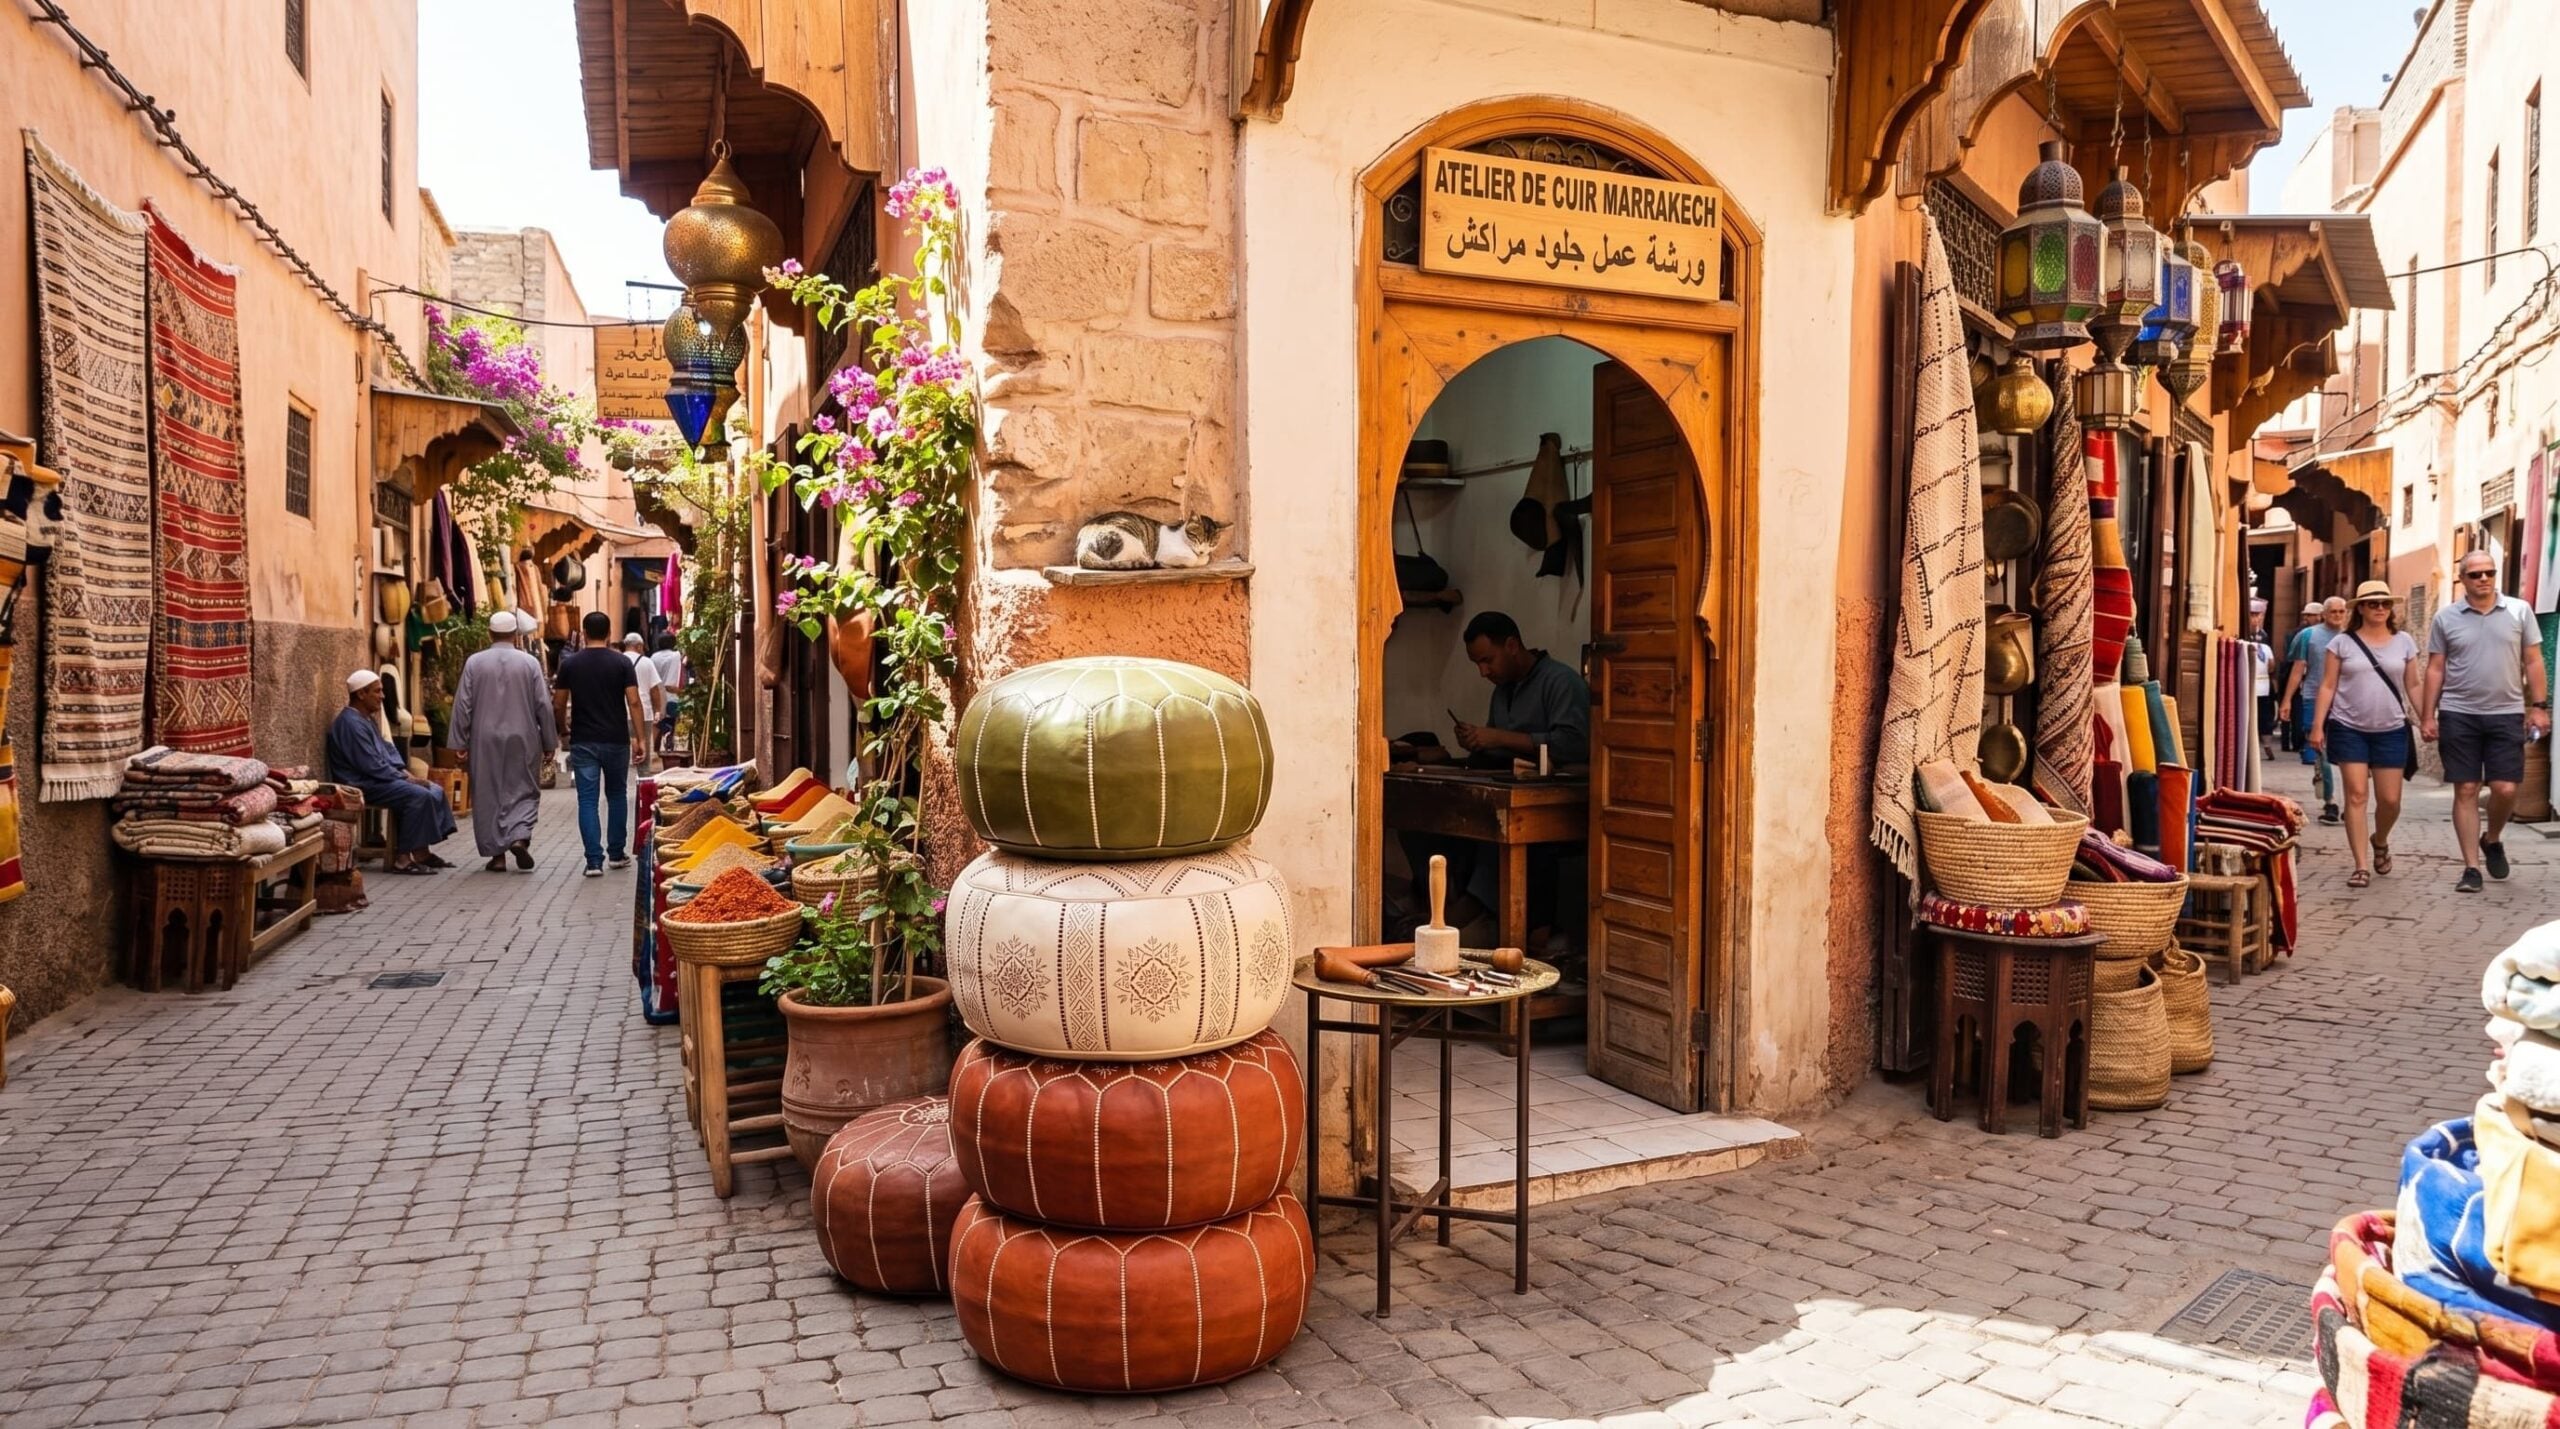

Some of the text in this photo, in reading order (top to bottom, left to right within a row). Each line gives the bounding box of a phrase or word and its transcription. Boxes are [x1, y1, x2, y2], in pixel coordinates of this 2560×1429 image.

[1434, 159, 1716, 229] ATELIER DE CUIR MARRAKECH
[1446, 215, 1706, 288] ورشة عمل جلود مراكش
